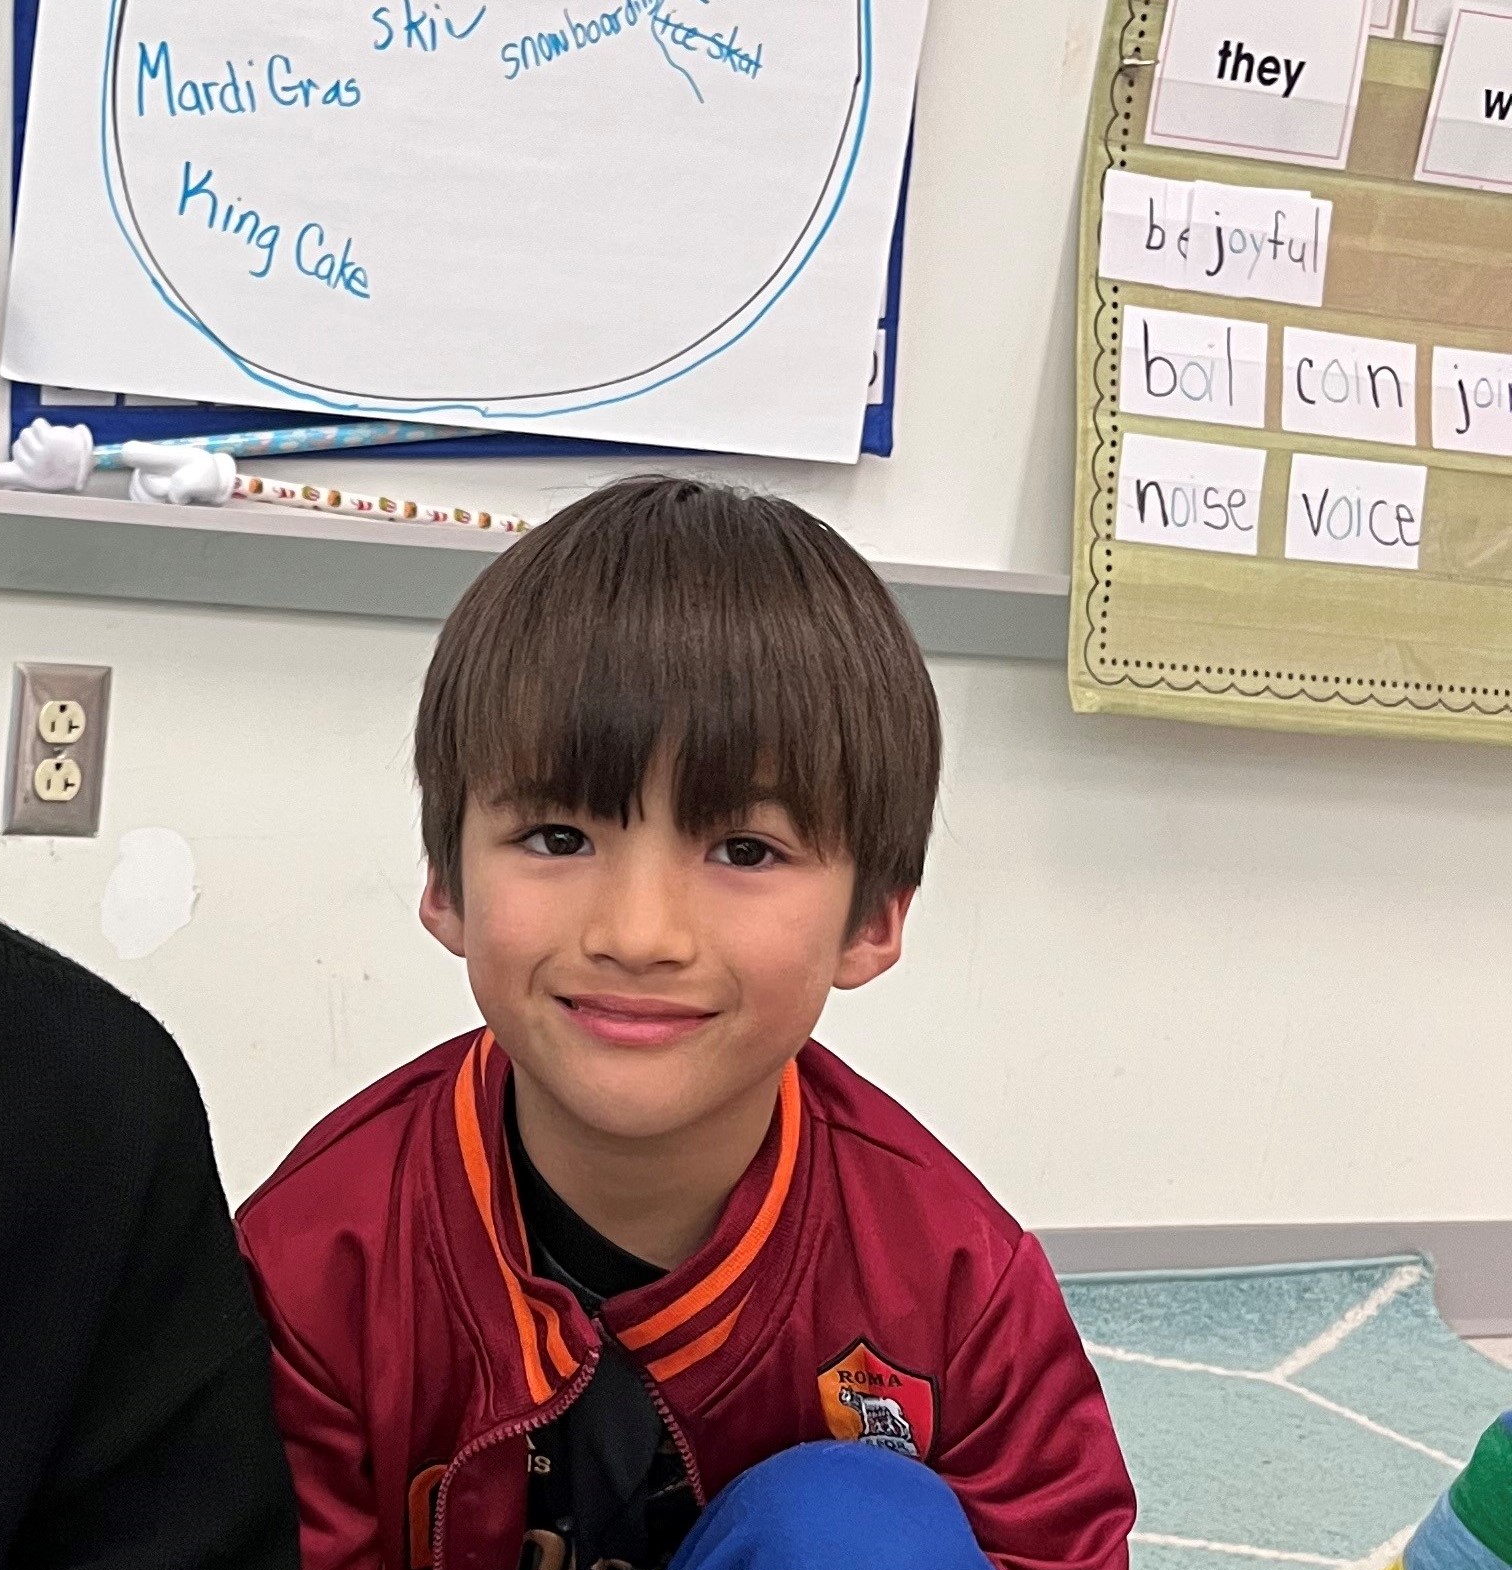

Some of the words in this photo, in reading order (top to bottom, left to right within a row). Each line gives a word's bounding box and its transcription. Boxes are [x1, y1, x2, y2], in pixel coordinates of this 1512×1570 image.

[137, 40, 258, 118] Mardi
[267, 53, 363, 108] Gras
[1217, 38, 1307, 98] they
[178, 160, 281, 279] King
[295, 222, 371, 300] Cake
[1205, 206, 1320, 281] joyful
[1295, 350, 1404, 409] coin
[1454, 363, 1512, 435] joi
[1135, 475, 1254, 531] noise
[836, 1369, 904, 1388] ROMA
